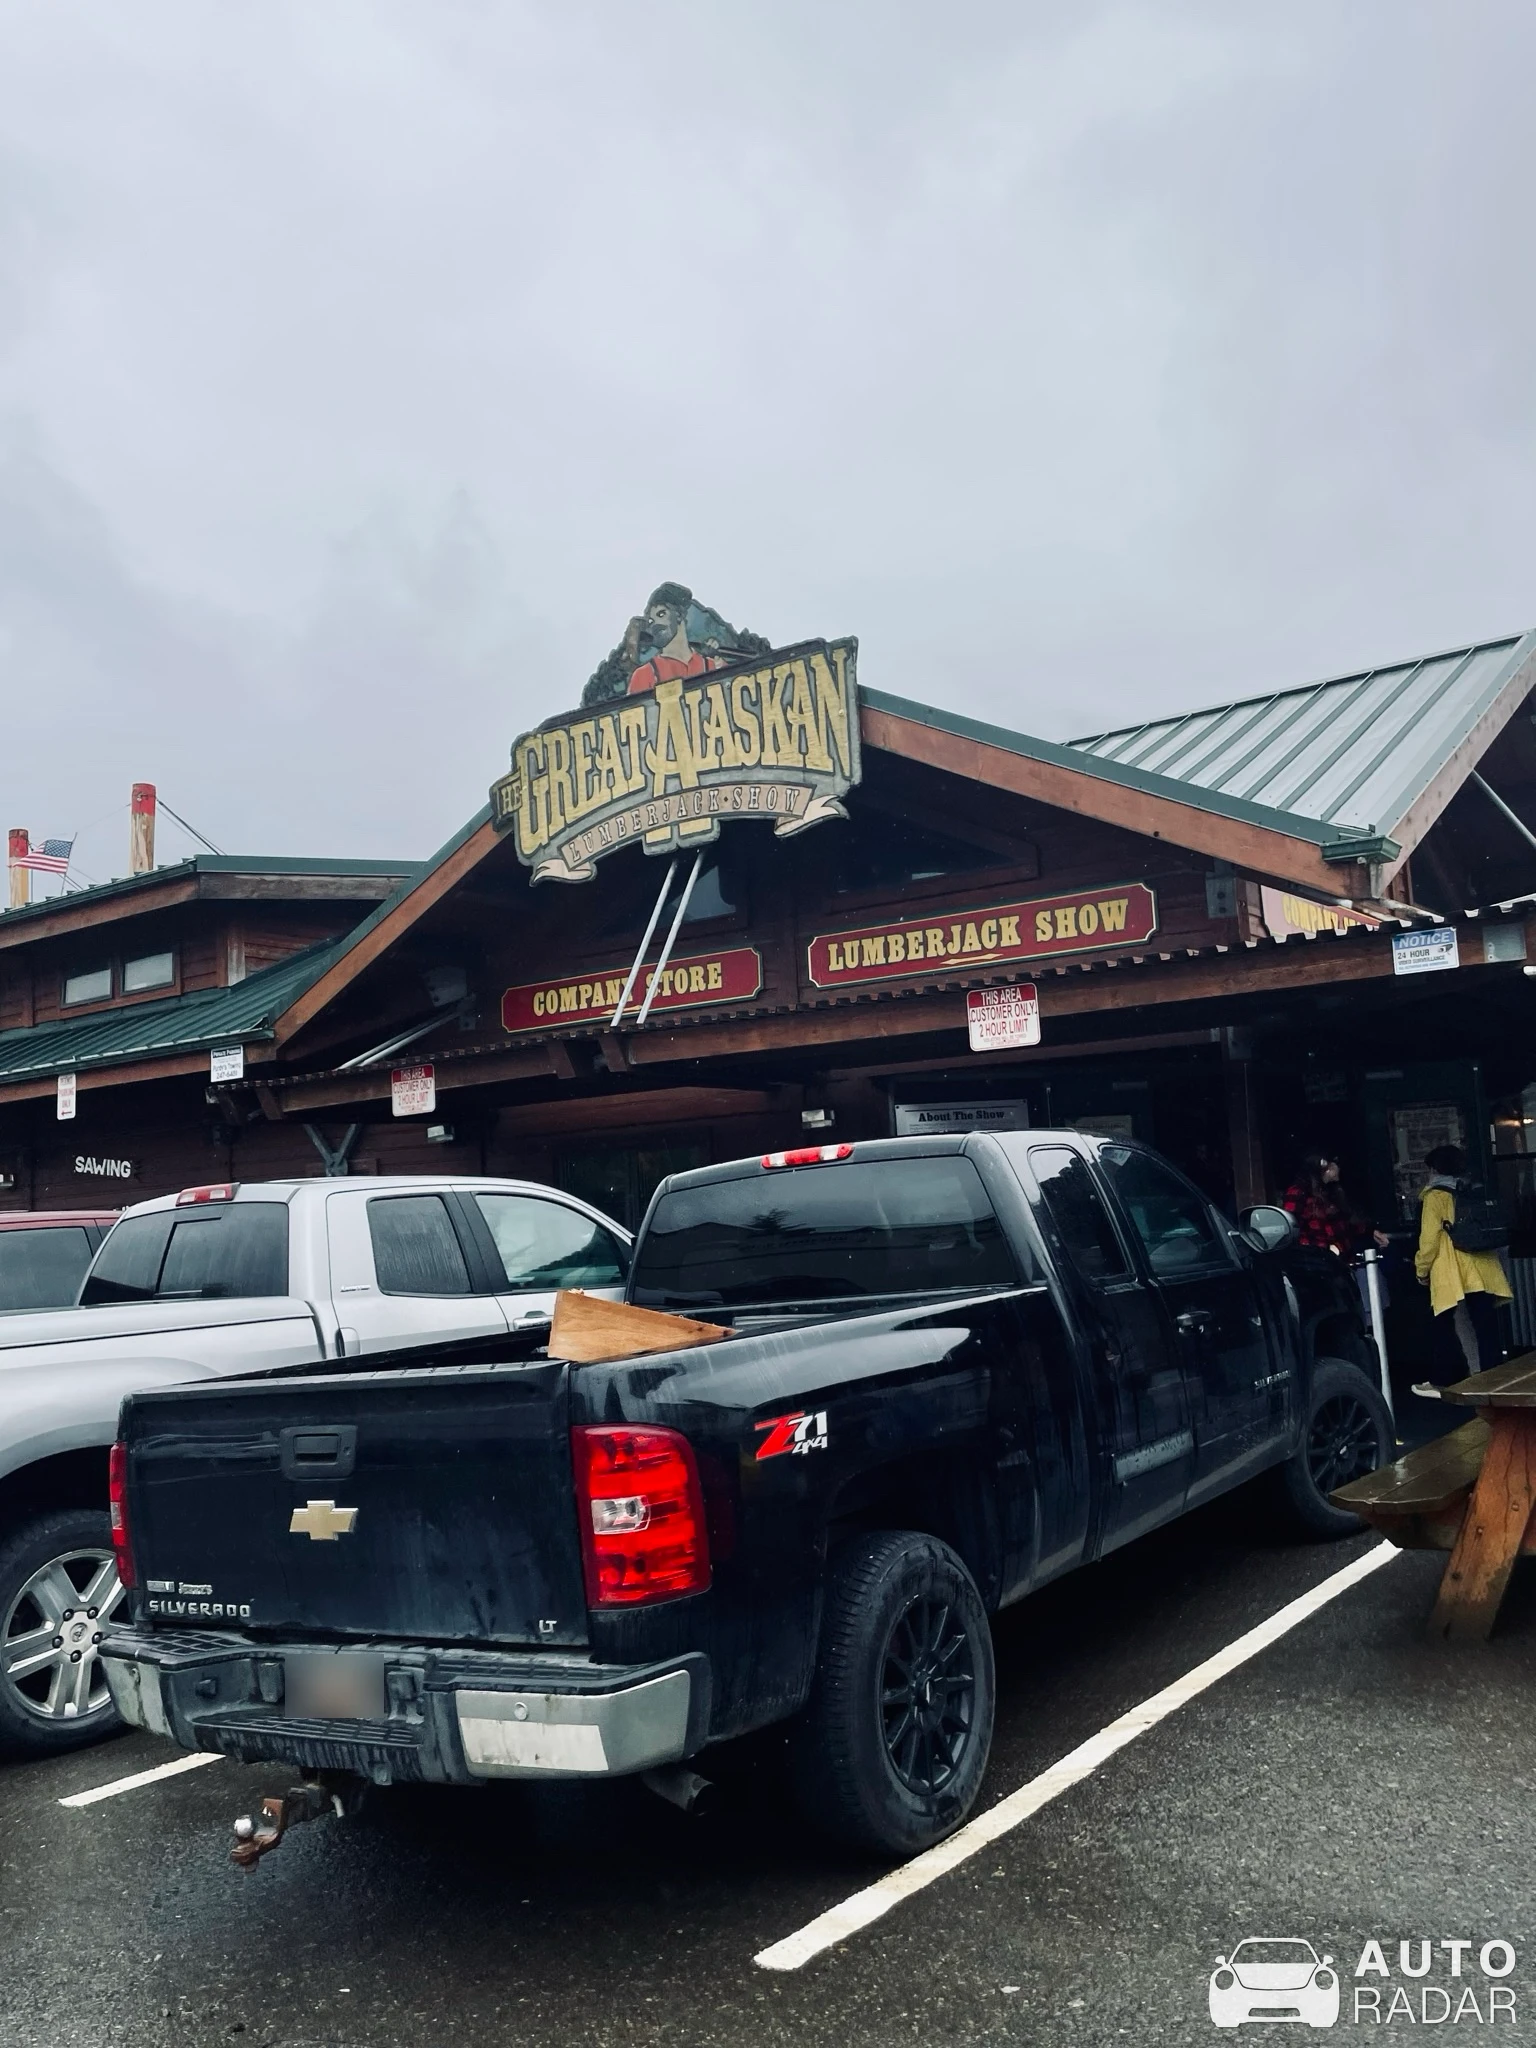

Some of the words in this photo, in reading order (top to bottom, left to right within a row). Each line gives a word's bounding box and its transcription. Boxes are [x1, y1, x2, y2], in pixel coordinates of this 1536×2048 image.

[515, 706, 647, 855] GREAT
[645, 648, 851, 843] ALASKAN
[498, 769, 522, 814] THE
[568, 788, 720, 862] LUMBERJACK
[731, 786, 800, 813] SHOW
[828, 915, 1021, 972] LUMBERJACK
[1035, 898, 1129, 942] SHOW
[1399, 931, 1451, 949] NOTICE
[1397, 952, 1407, 960] 24
[1409, 949, 1430, 958] HOUR
[981, 991, 999, 1006] THIS
[1000, 987, 1022, 1003] AREA
[971, 1004, 1013, 1022] CUSTOMER
[1014, 1001, 1035, 1017] ONLY
[979, 1024, 984, 1037] 2
[985, 1022, 1007, 1036] HOUR
[1009, 1018, 1028, 1034] LIMIT
[412, 1067, 425, 1079] AREA
[918, 1110, 950, 1122] About
[952, 1108, 973, 1121] The
[975, 1107, 1005, 1119] Show
[75, 1155, 132, 1178] SAWING
[754, 1411, 828, 1461] Z71
[149, 1600, 251, 1618] SILVERADO
[539, 1619, 558, 1633] LT
